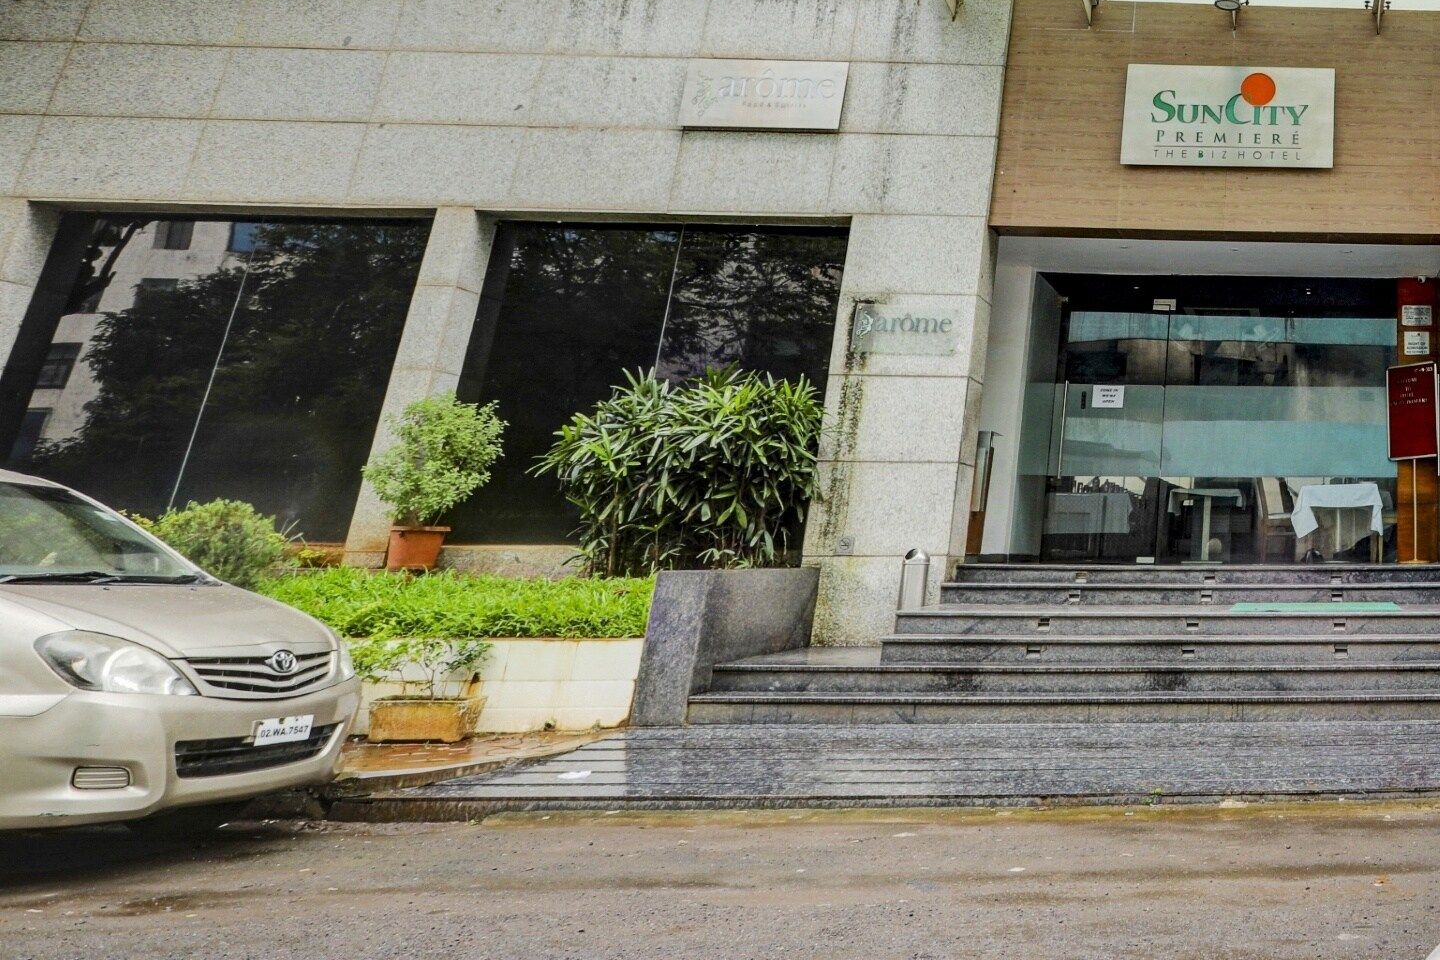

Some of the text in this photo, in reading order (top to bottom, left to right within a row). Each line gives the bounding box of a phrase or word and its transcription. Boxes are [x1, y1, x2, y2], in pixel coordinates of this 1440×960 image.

[718, 68, 837, 100] arôme
[1153, 149, 1301, 161] THE BIZ HOTEL
[874, 312, 952, 334] arôme
